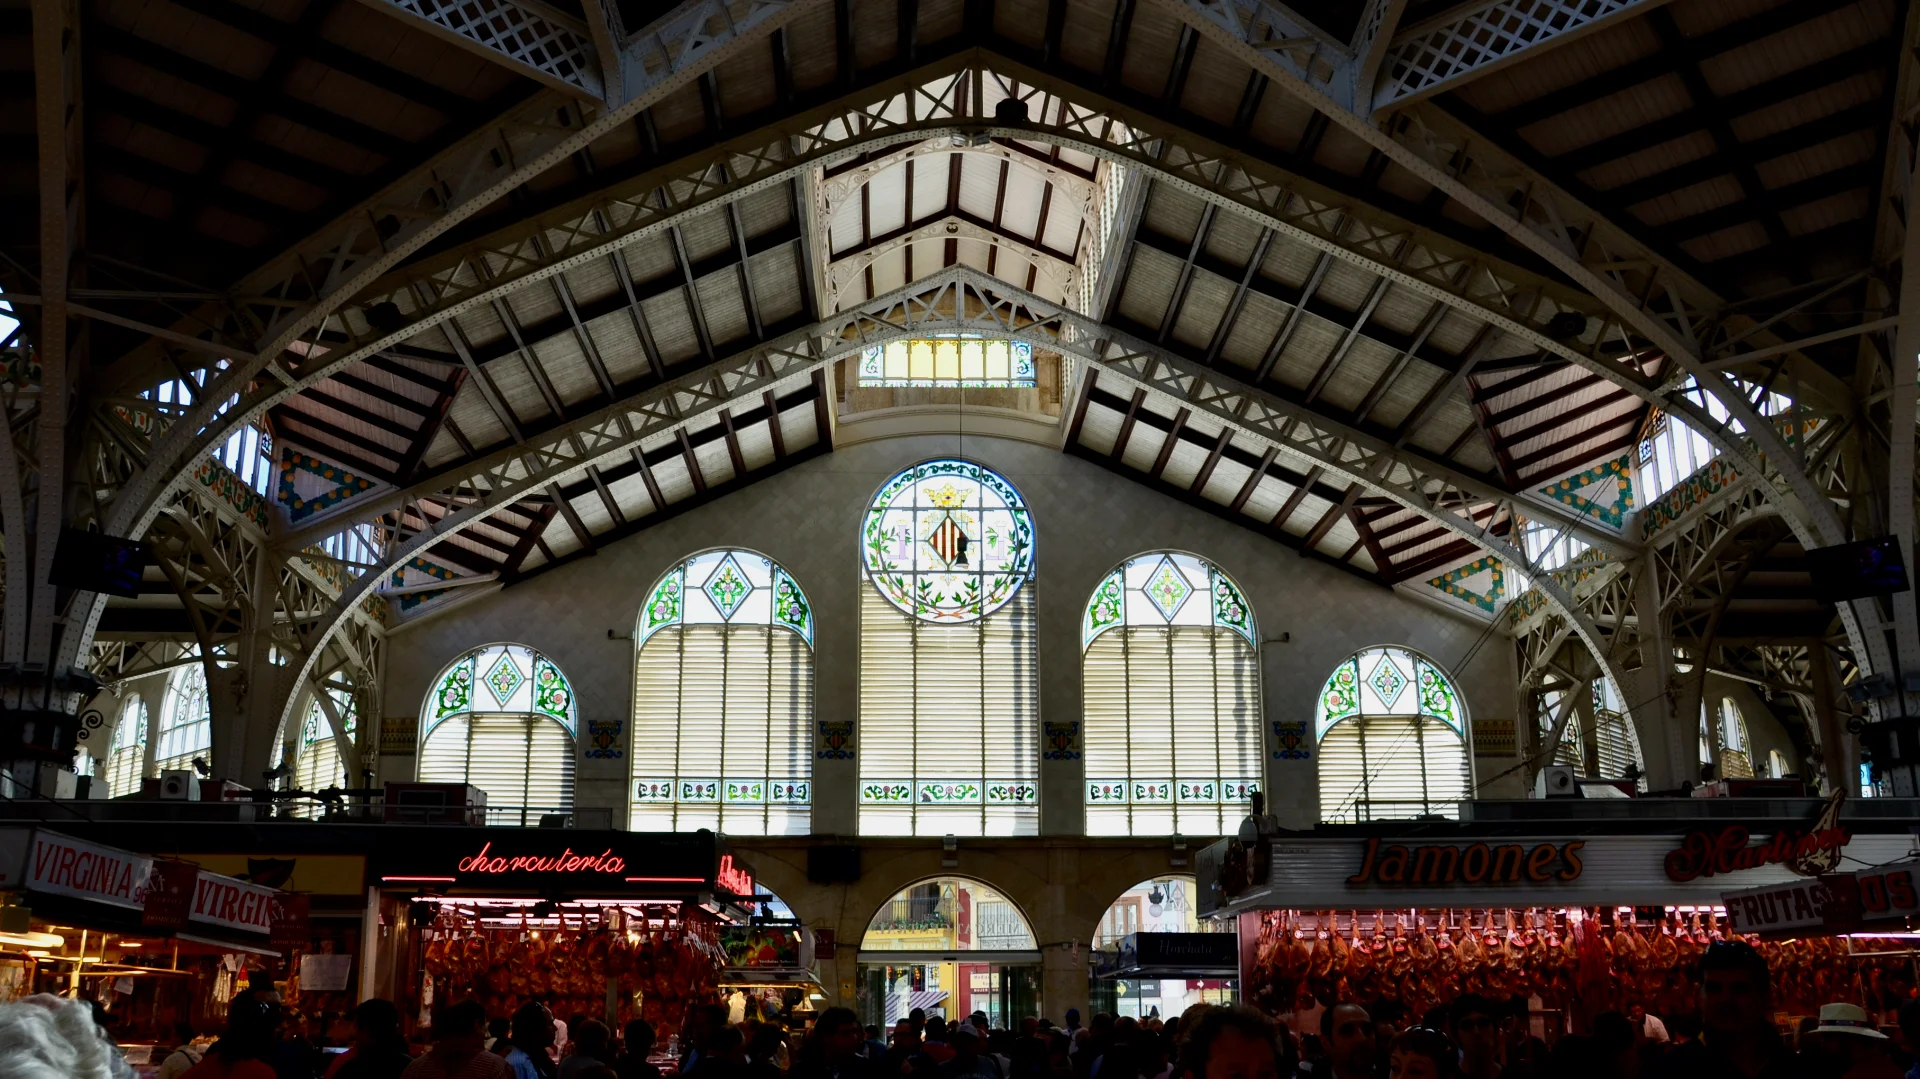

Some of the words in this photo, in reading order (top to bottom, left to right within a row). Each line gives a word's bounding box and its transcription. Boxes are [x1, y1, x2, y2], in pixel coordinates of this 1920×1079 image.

[34, 841, 132, 898] VIRGINIA
[458, 841, 626, 873] charcutería
[1346, 837, 1586, 884] Jamones
